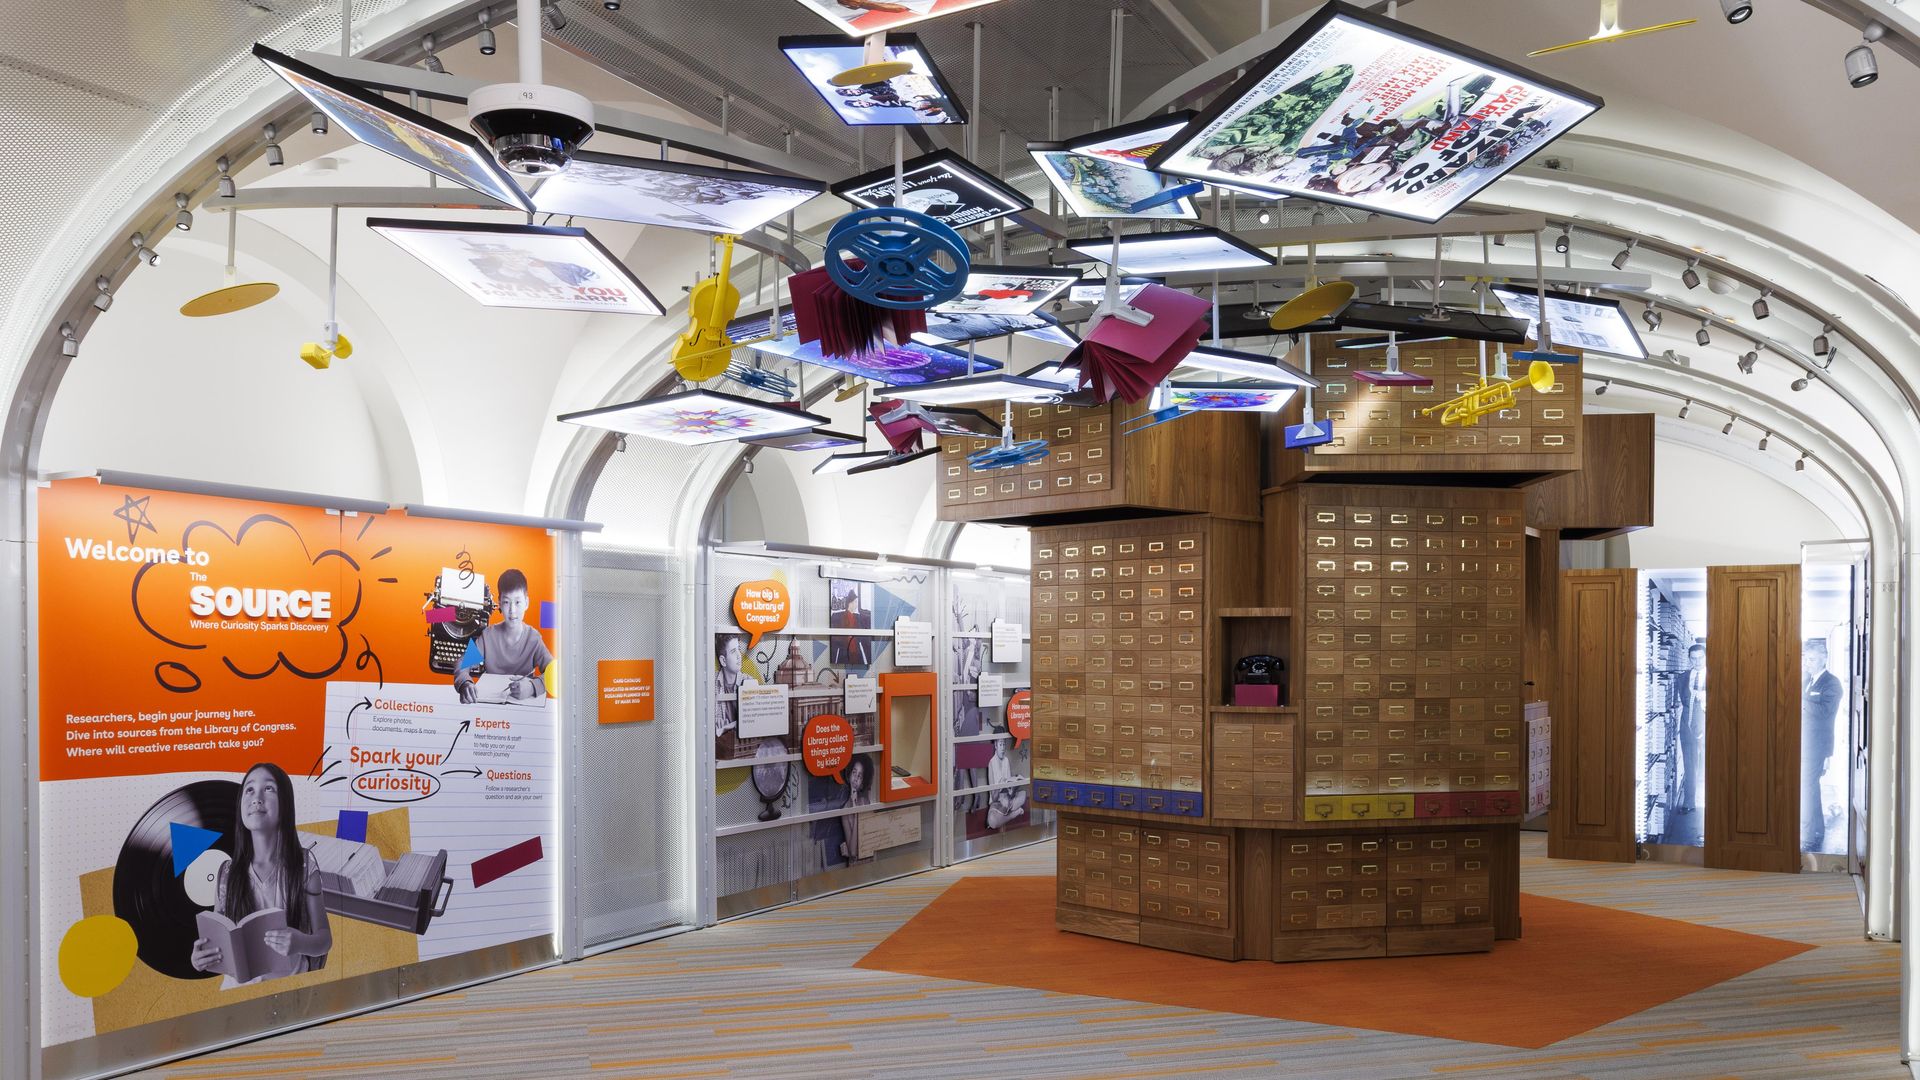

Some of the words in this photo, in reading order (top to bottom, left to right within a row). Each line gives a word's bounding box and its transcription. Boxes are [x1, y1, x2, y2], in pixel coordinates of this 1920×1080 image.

[1414, 61, 1452, 88] FRANK
[522, 92, 533, 100] 93
[1362, 76, 1399, 102] HALEY
[1377, 79, 1407, 100] LAHR
[1378, 76, 1422, 107] BOLGER
[1220, 89, 1260, 120] MASTERPIECE
[1371, 89, 1417, 121] MORGAN
[1495, 89, 1528, 117] JUDY
[1431, 85, 1524, 151] GARLAND
[1407, 105, 1545, 194] WIZARD
[1437, 126, 1479, 162] OF
[1386, 163, 1429, 193] OZ
[486, 282, 564, 294] WANT
[570, 286, 625, 296] YOU
[64, 537, 180, 566] Welcome
[185, 548, 210, 566] to
[190, 572, 207, 582] The
[190, 585, 332, 618] SOURCE
[746, 589, 760, 598] How
[762, 588, 772, 600] big
[774, 590, 779, 598] is
[741, 601, 752, 610] the
[753, 602, 776, 612] Library
[778, 602, 784, 610] of
[190, 620, 219, 630] Where
[220, 621, 259, 632] Curiosity
[260, 622, 288, 632] Sparks
[290, 622, 329, 632] Discovery
[746, 613, 780, 624] Congress?
[374, 698, 434, 713] Collections
[66, 713, 136, 724] Researchers,
[138, 711, 167, 723] begin
[169, 711, 192, 722] your
[194, 709, 231, 721] journey
[233, 709, 256, 718] here.
[373, 716, 392, 725] Explore
[475, 718, 511, 730] Experts
[66, 730, 90, 740] Dive
[93, 729, 115, 739] into
[117, 728, 157, 738] sources
[159, 726, 183, 737] from
[185, 725, 202, 735] the
[204, 724, 238, 736] Library
[240, 723, 251, 733] of
[252, 722, 297, 734] Congress.
[808, 737, 828, 745] Library
[829, 734, 848, 743] collect
[66, 747, 103, 757] Where
[105, 745, 126, 755] will
[128, 743, 171, 754] creative
[173, 740, 216, 751] research
[218, 739, 240, 749] take
[242, 737, 264, 750] you?
[811, 748, 829, 757] things
[350, 746, 401, 768] Spark
[405, 753, 442, 770] your
[817, 760, 824, 768] by
[826, 757, 840, 766] kids?
[357, 773, 431, 795] curiosity
[487, 769, 532, 782] Questions
